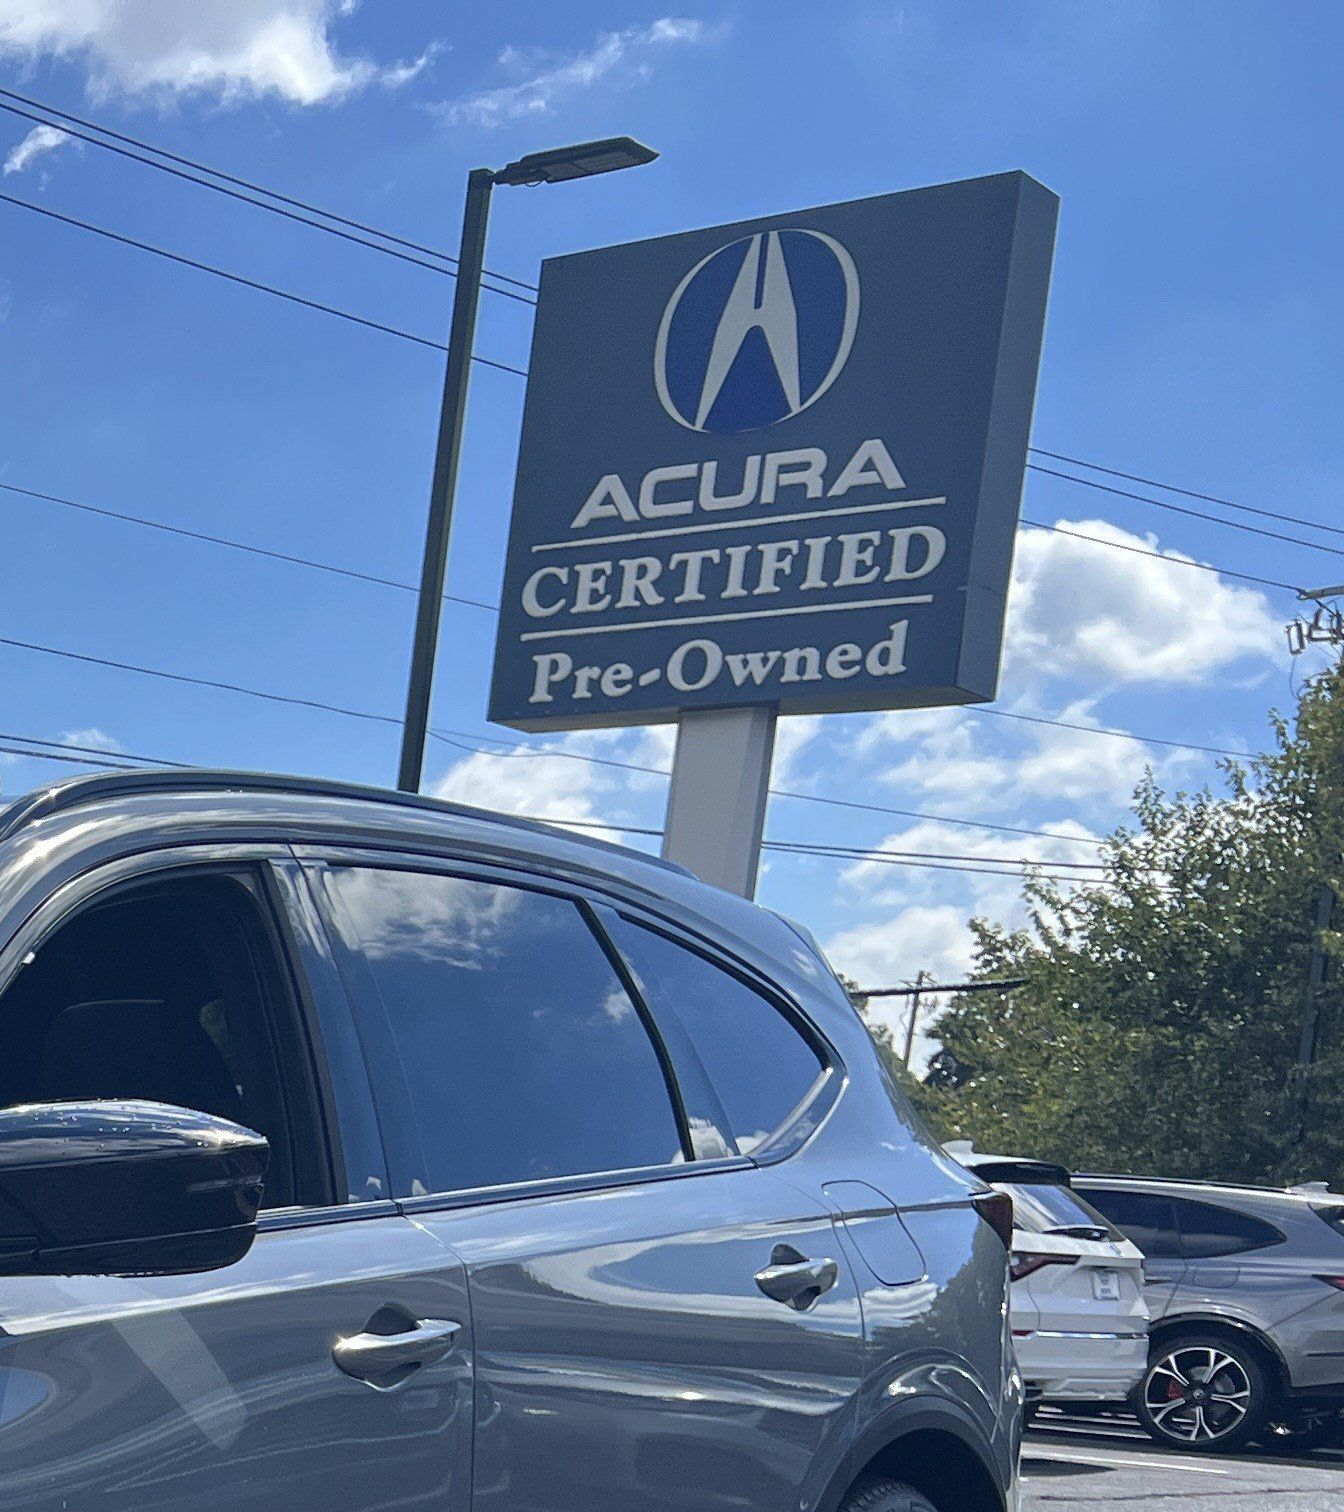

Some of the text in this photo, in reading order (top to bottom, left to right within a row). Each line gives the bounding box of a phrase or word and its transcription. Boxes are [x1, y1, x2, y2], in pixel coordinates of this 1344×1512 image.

[570, 438, 906, 529] ACURA
[521, 525, 947, 618] CERTIFIED
[527, 620, 909, 703] Pre-Owned
